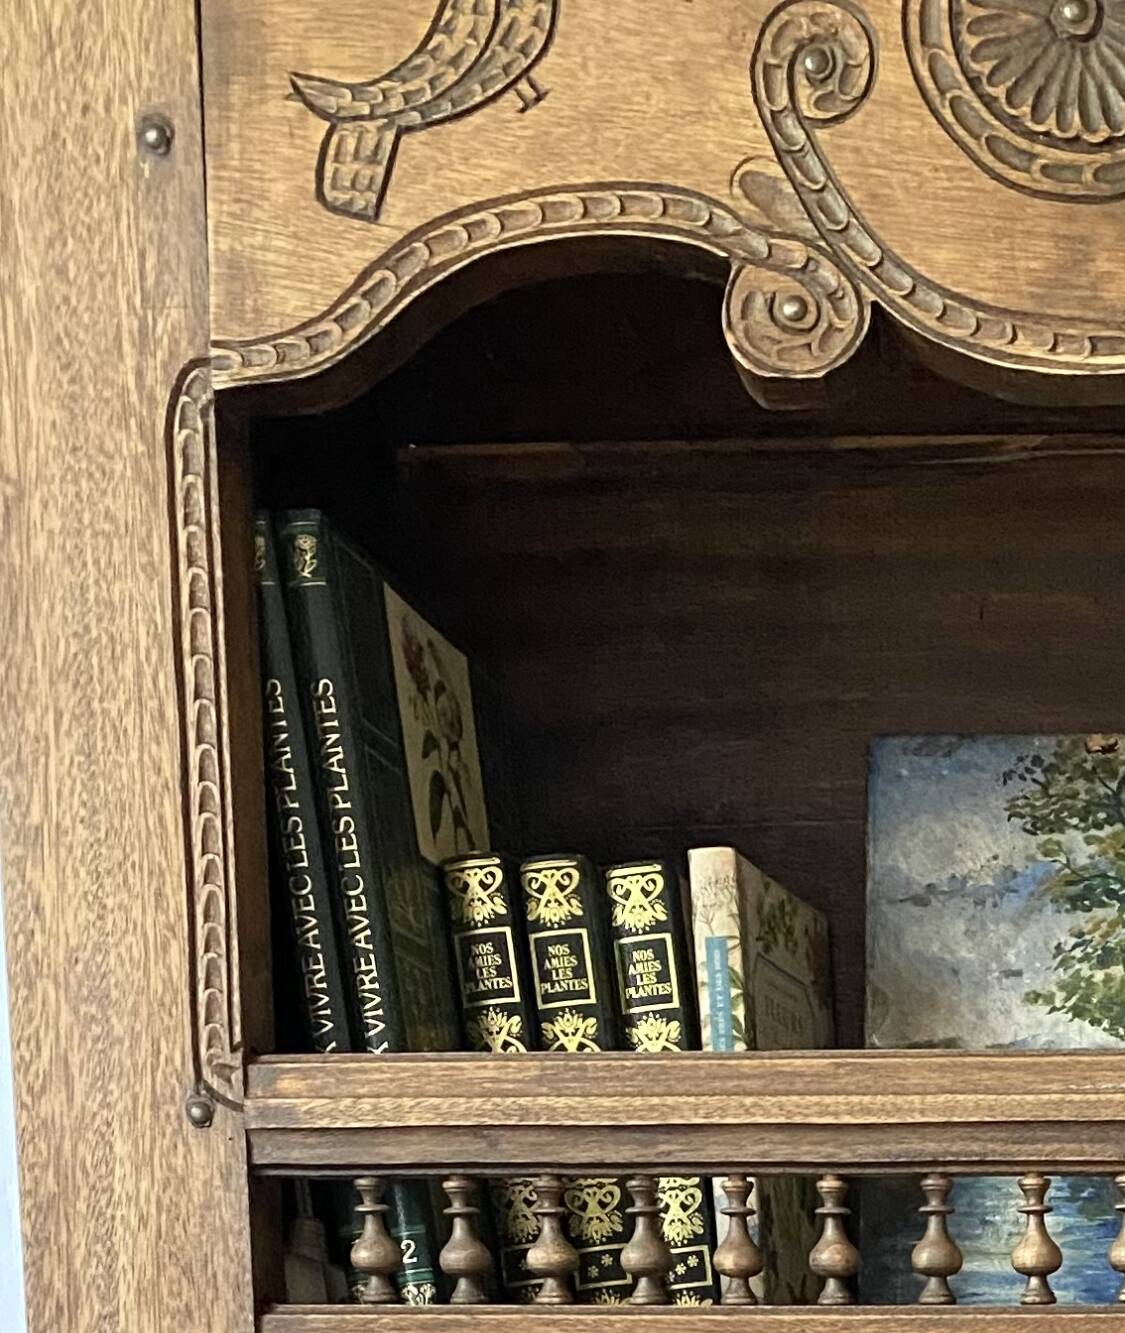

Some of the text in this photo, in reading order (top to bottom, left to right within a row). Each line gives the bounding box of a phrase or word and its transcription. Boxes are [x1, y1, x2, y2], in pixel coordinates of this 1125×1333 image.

[266, 678, 300, 811] PLANTES
[311, 678, 352, 810] PLANTES
[282, 816, 310, 872] LES
[332, 816, 361, 871] LES
[289, 874, 322, 950] AVEC
[341, 874, 374, 950] AVEC
[471, 942, 494, 955] NOS
[547, 943, 571, 956] NOS
[632, 948, 655, 961] NOS
[468, 953, 503, 968] AMIES
[543, 955, 579, 971] AMIES
[628, 959, 663, 976] AMIES
[475, 966, 498, 979] LES
[551, 968, 574, 981] LES
[635, 972, 658, 986] LES
[464, 976, 513, 993] PLANTES
[540, 977, 589, 994] PLANTES
[624, 982, 673, 999] PLANTES
[302, 953, 335, 1038] VIVRE
[353, 953, 387, 1039] VIVRE
[401, 1239, 418, 1264] 2
